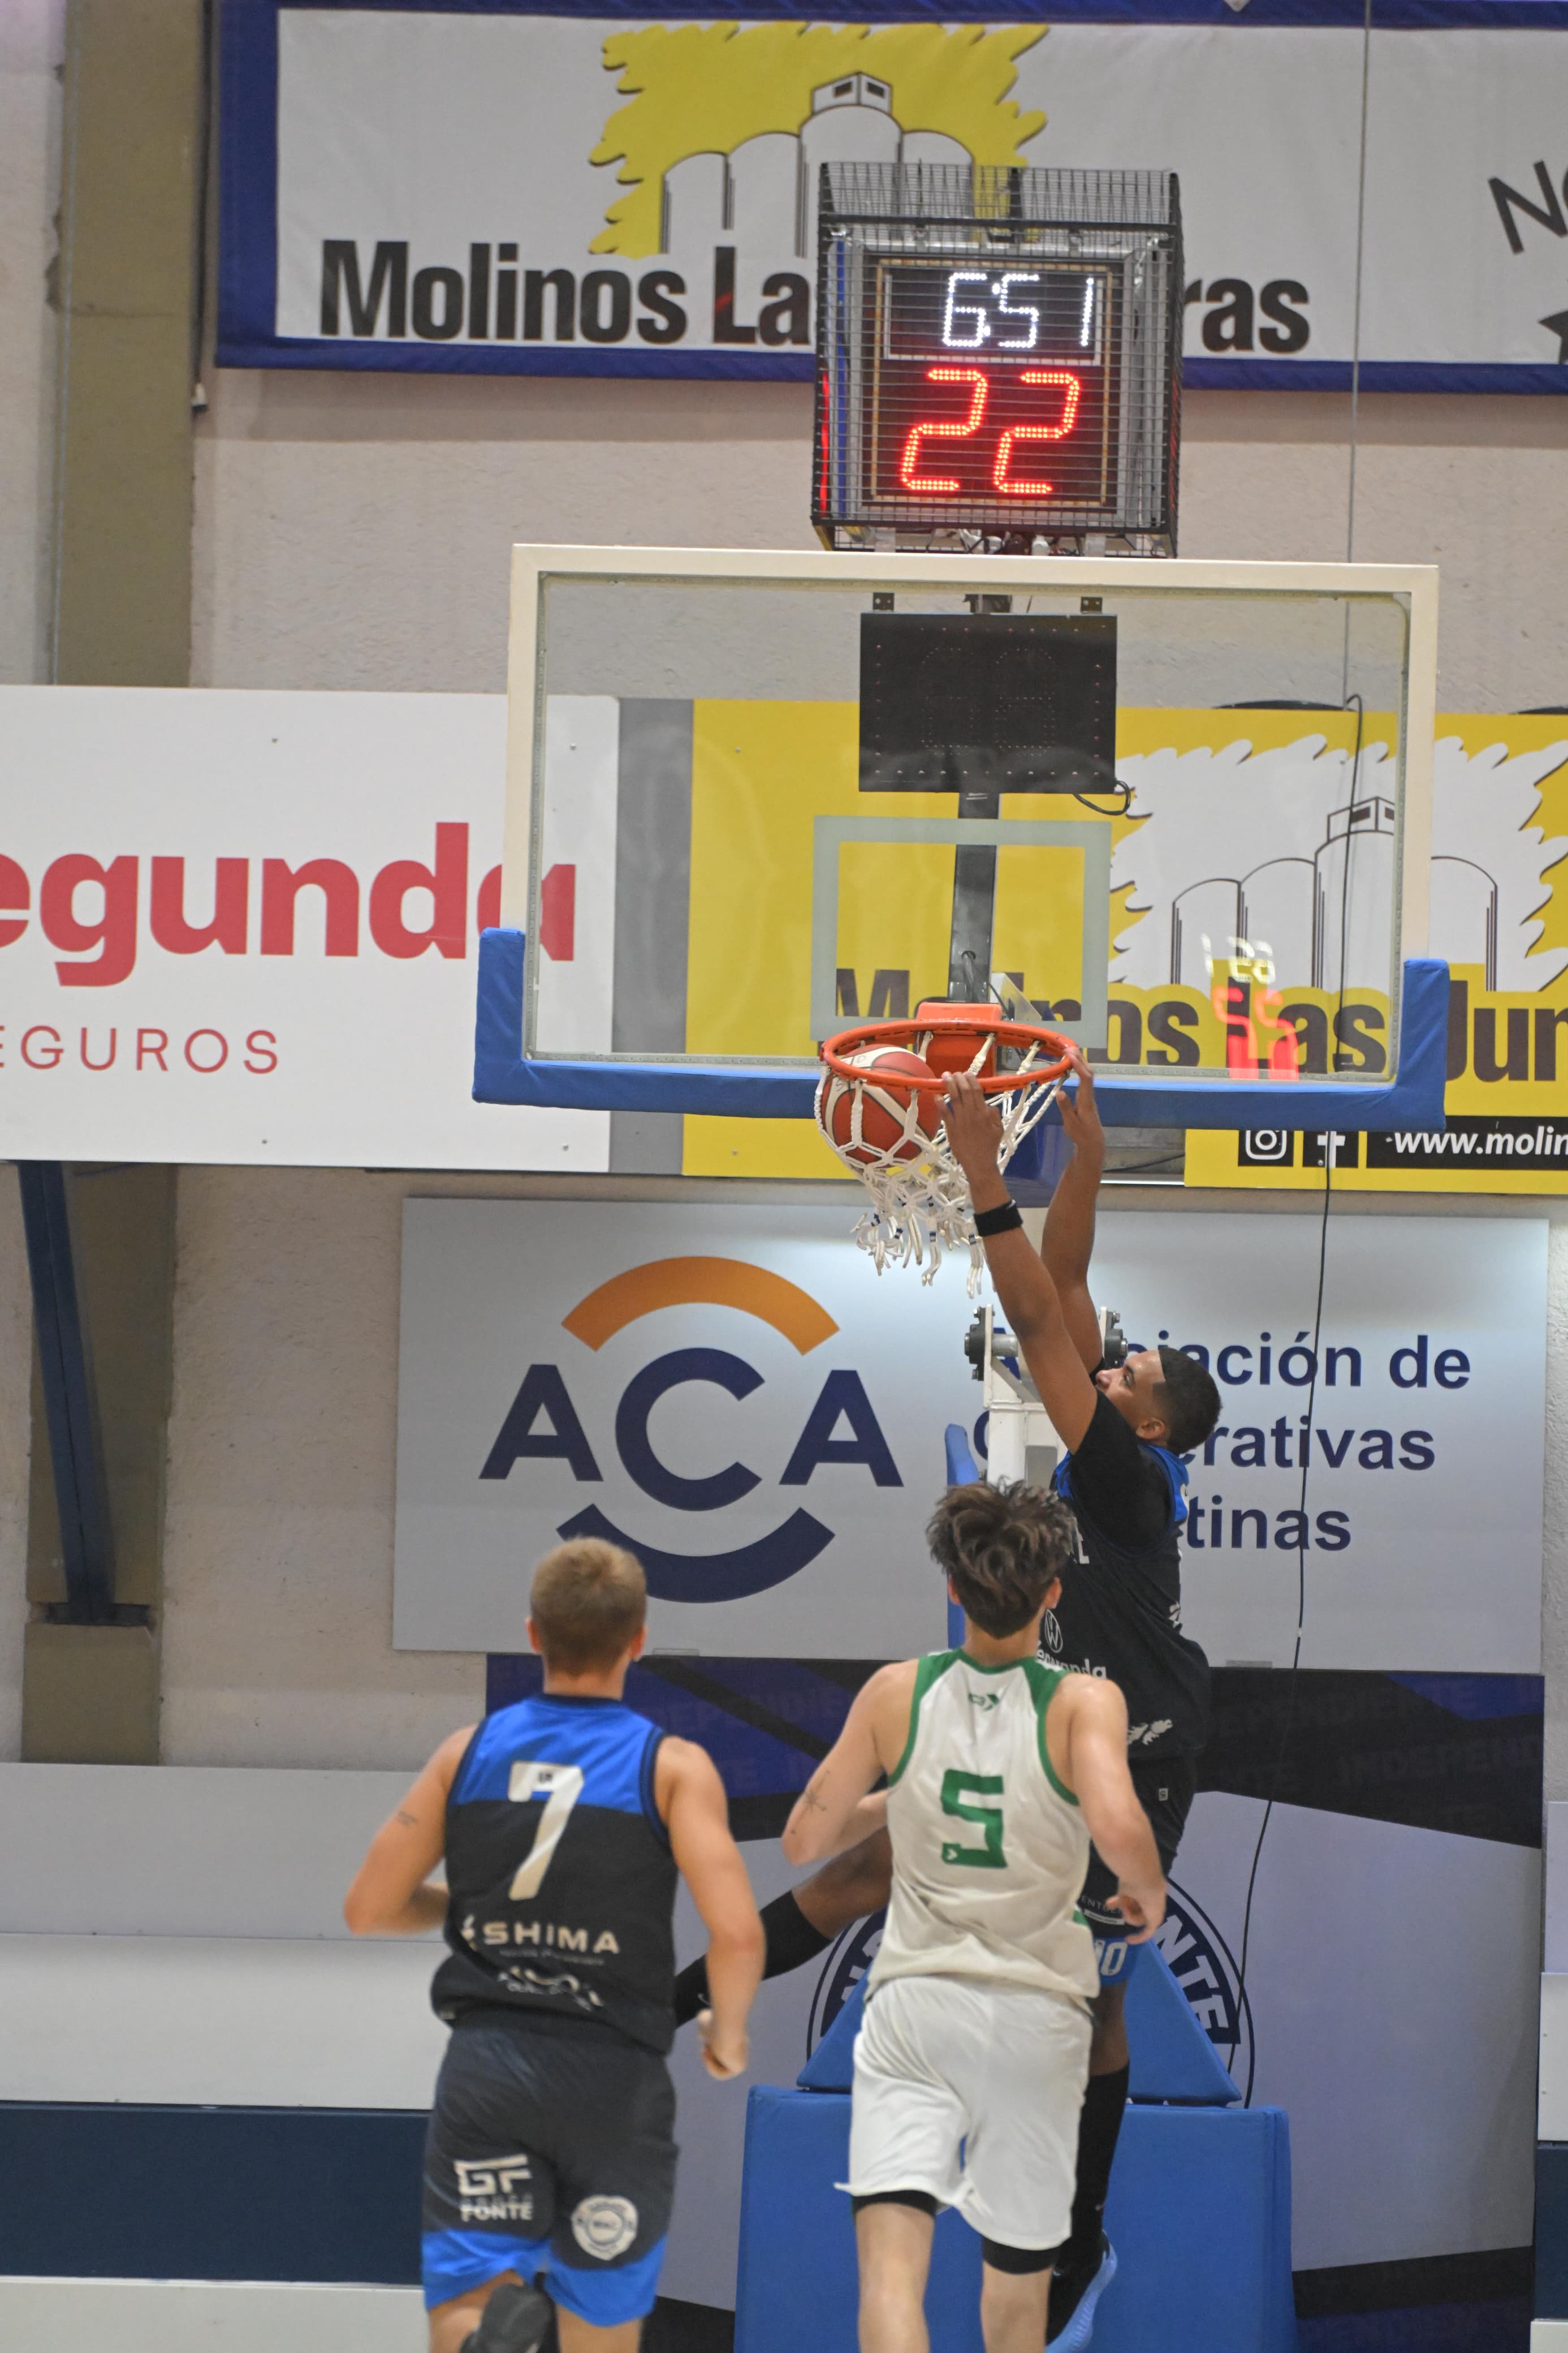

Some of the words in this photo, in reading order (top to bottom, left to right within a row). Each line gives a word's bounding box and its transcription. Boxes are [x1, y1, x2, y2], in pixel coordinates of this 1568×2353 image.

[321, 240, 686, 344] Molinos
[713, 246, 810, 346] La
[901, 367, 1081, 494] 22
[0, 1025, 278, 1073] GUROS
[1226, 975, 1386, 1075] Las
[1389, 1334, 1471, 1390] de
[479, 1348, 904, 1511] ACA
[509, 1761, 584, 1901] 7
[941, 1769, 1009, 1869] 5
[460, 2203, 533, 2222] FONTE
